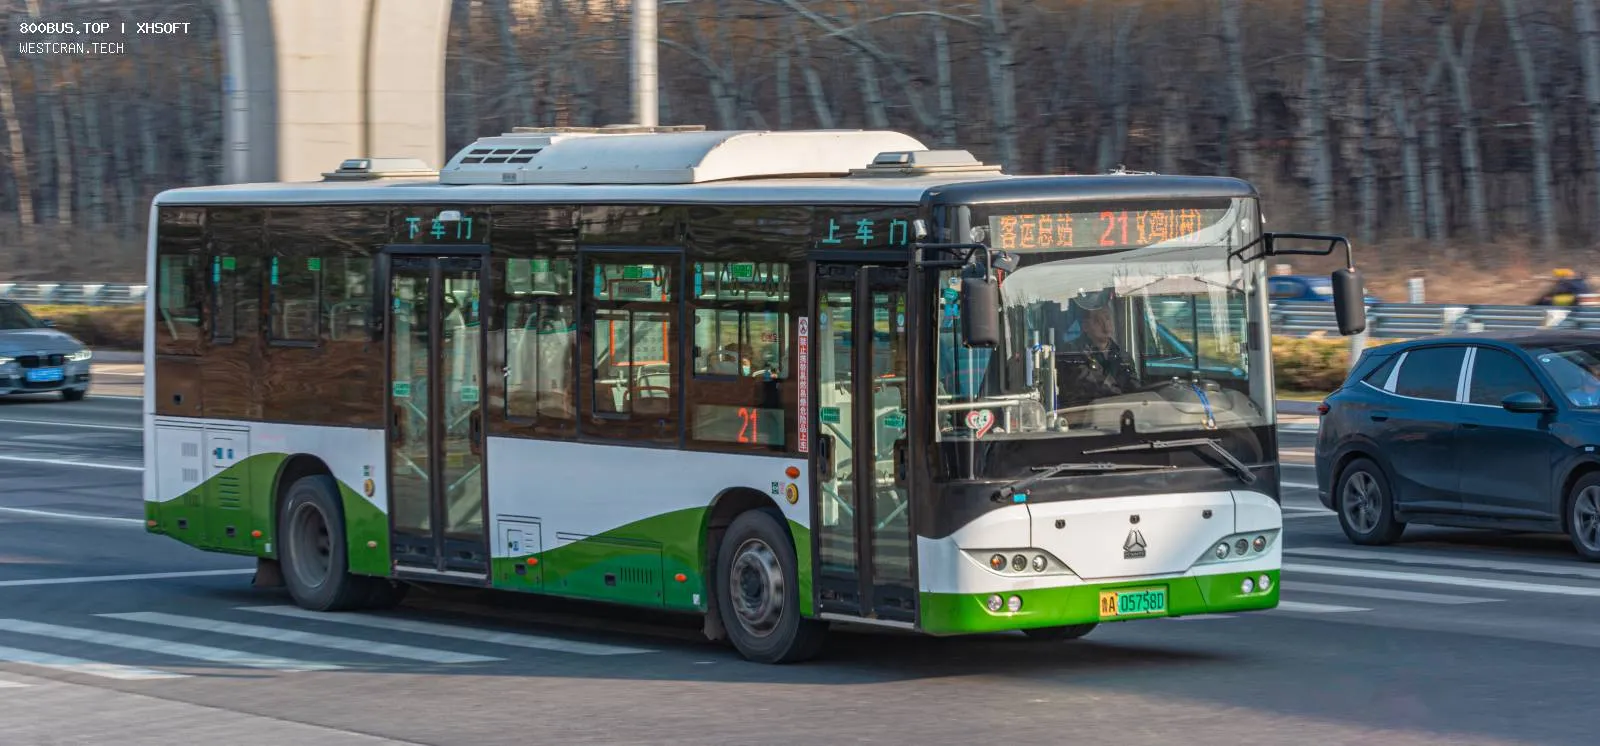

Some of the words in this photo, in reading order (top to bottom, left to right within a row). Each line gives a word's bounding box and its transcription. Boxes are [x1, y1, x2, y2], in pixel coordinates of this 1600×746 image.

[405, 216, 473, 240] 下车门
[822, 218, 908, 245] 上车门
[1000, 211, 1073, 249] 客运总站
[1100, 210, 1128, 247] 21
[737, 407, 758, 443] 21
